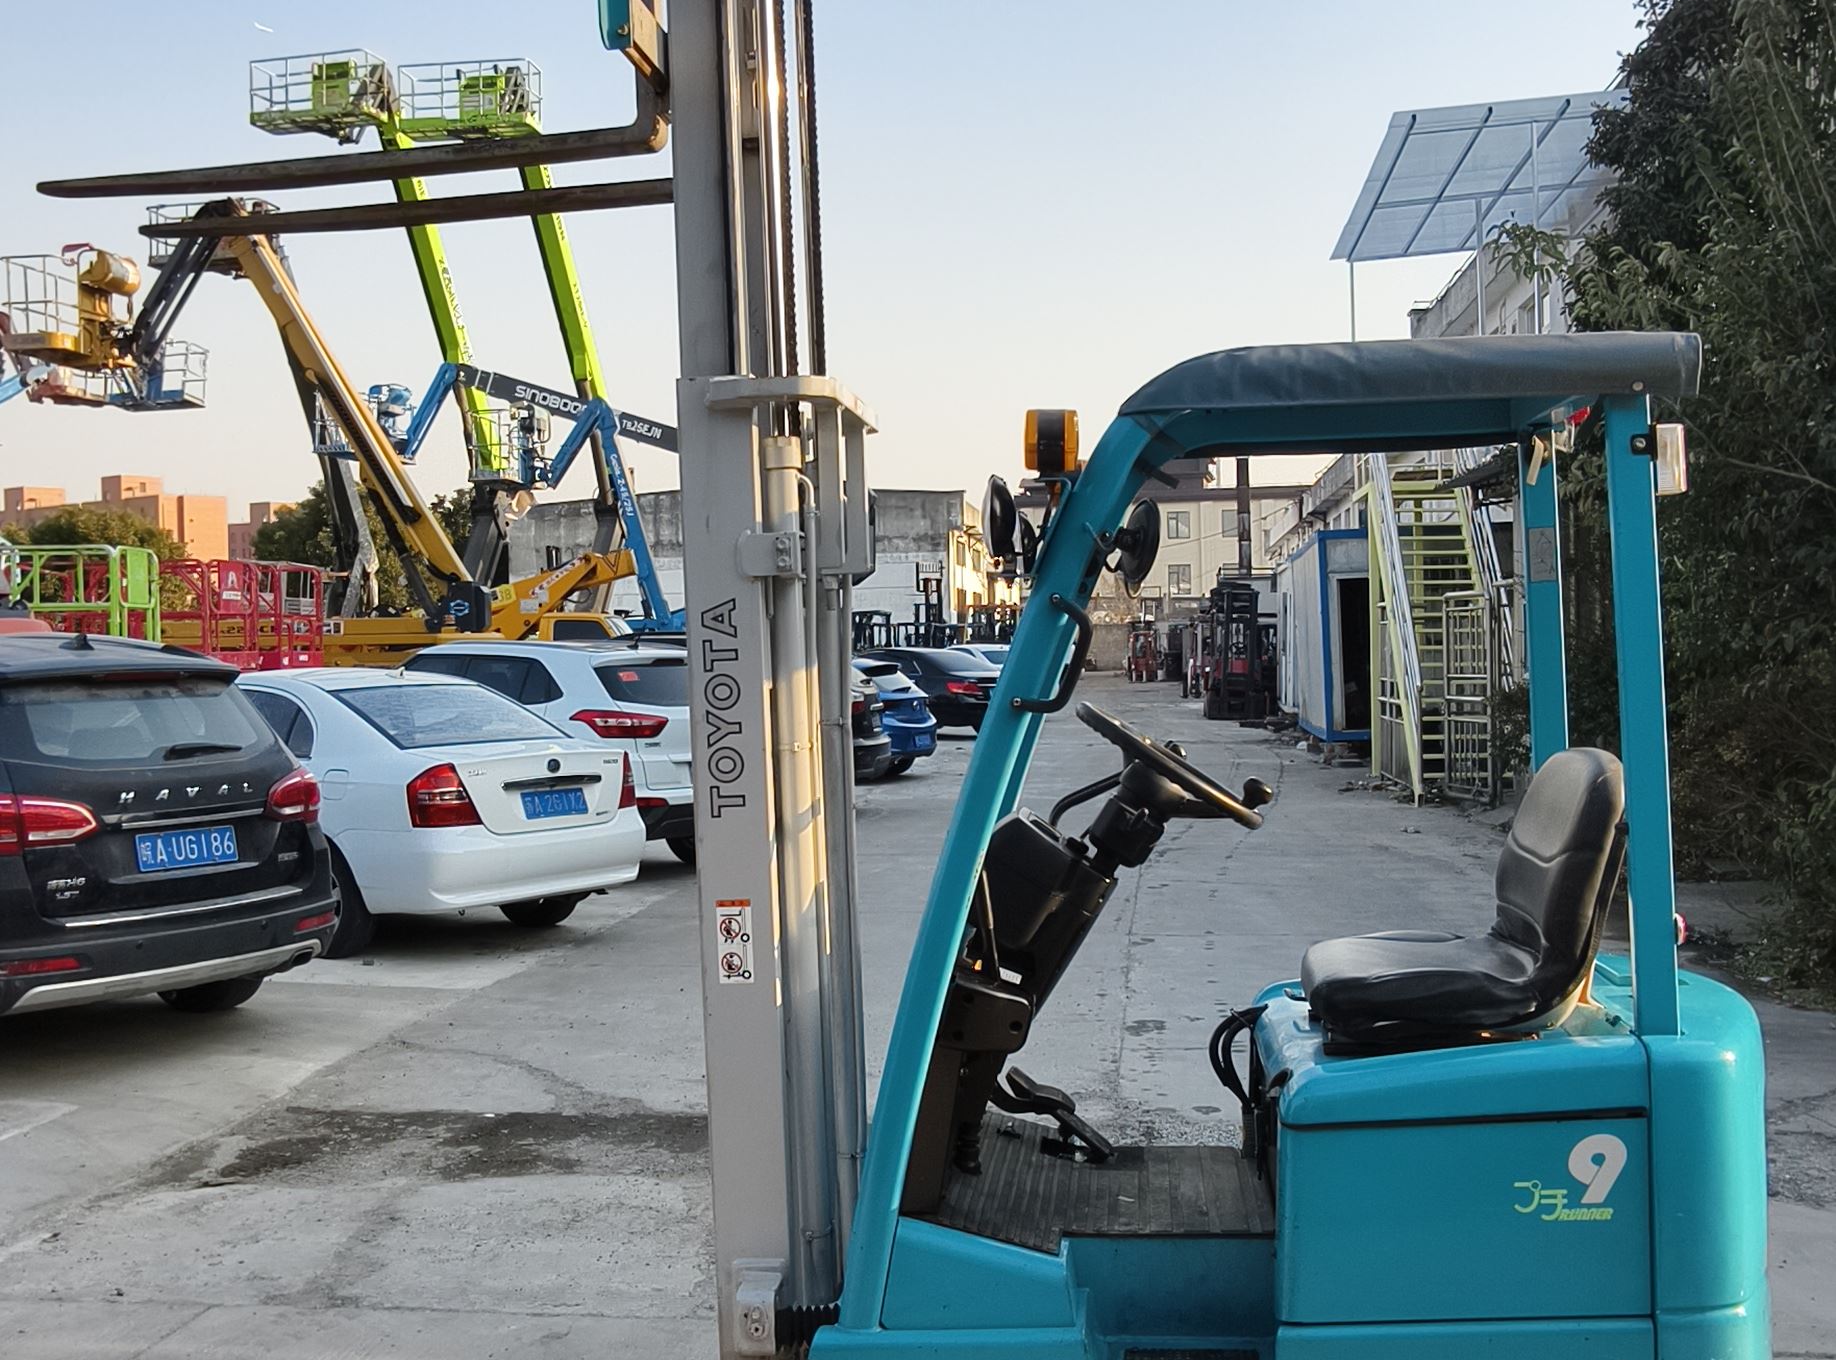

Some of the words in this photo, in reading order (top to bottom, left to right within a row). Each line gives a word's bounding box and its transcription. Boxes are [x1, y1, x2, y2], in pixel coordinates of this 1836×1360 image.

[514, 385, 588, 415] SINOBOO
[701, 597, 746, 818] TOYOTA
[118, 781, 253, 804] HAVAL
[1568, 1133, 1628, 1204] 9
